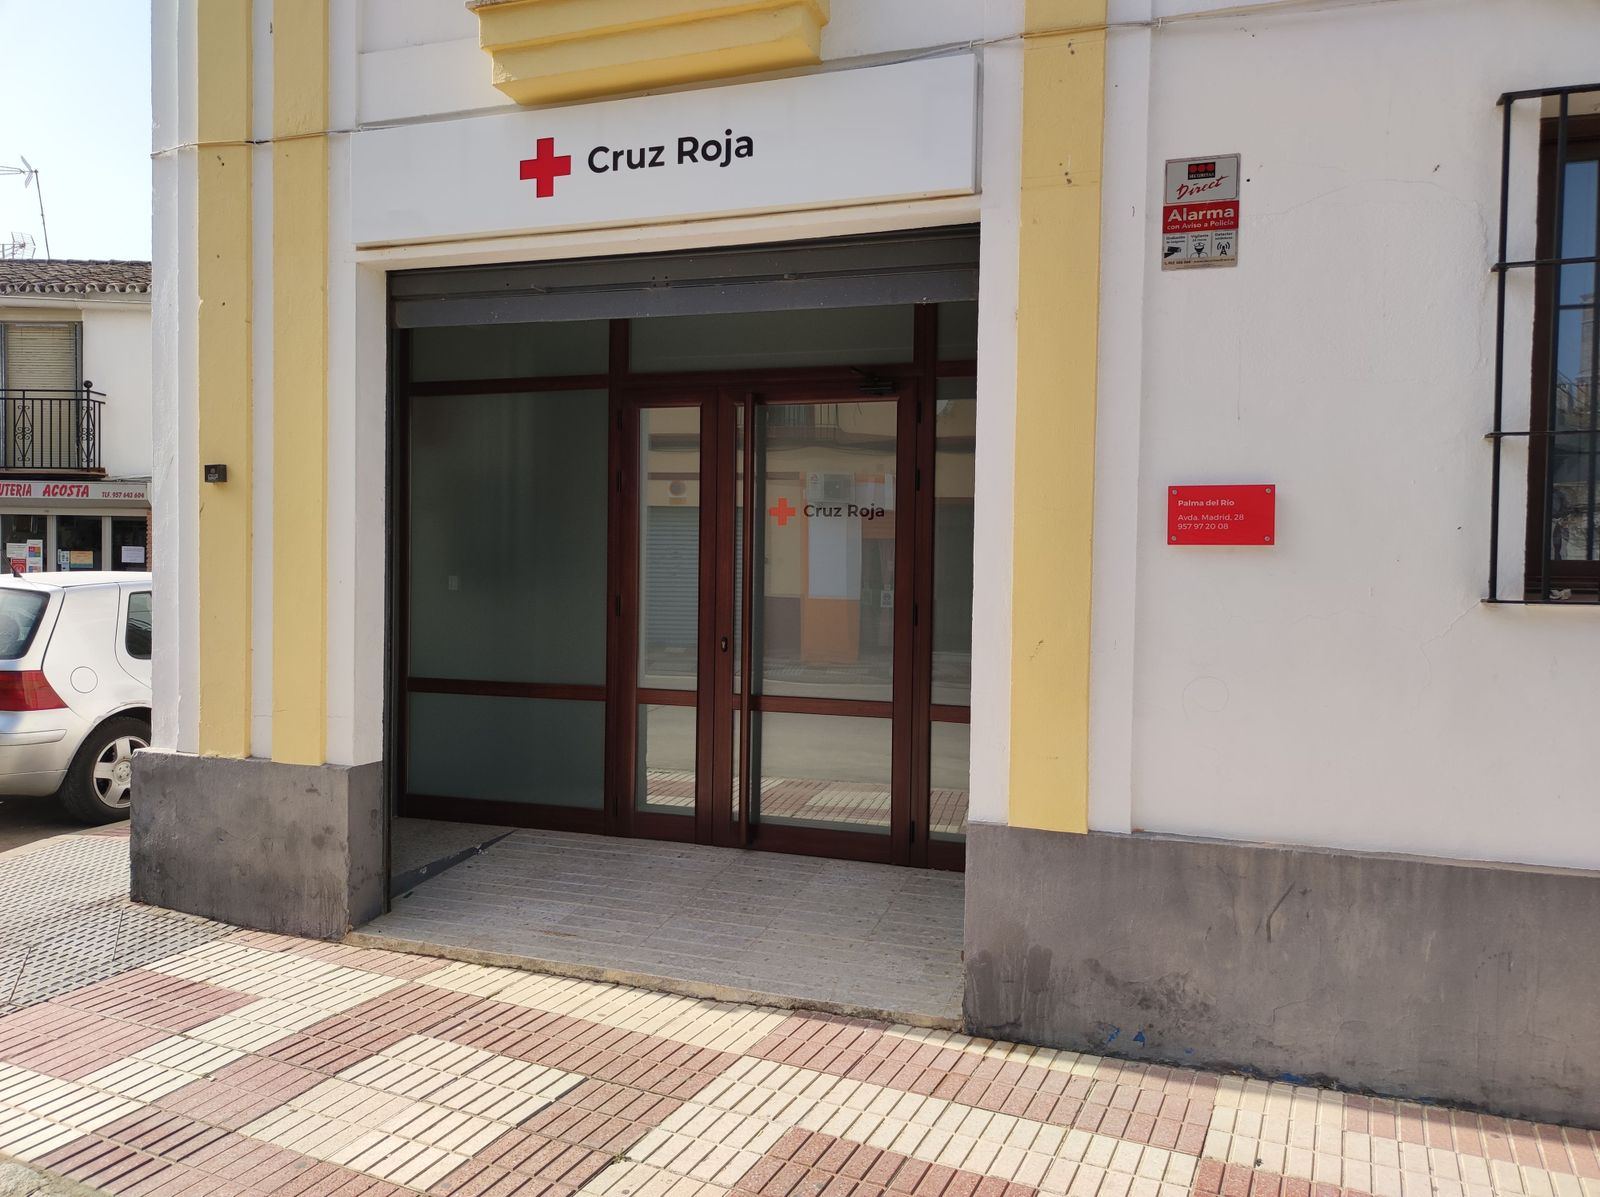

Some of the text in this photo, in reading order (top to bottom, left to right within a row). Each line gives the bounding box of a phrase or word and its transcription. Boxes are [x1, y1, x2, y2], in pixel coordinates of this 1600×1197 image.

[588, 128, 754, 174] Cruz Roja
[1176, 175, 1229, 200] Direct
[1168, 208, 1235, 222] Alarma
[42, 484, 90, 498] ACOSTA
[803, 502, 885, 520] Cruz Roja
